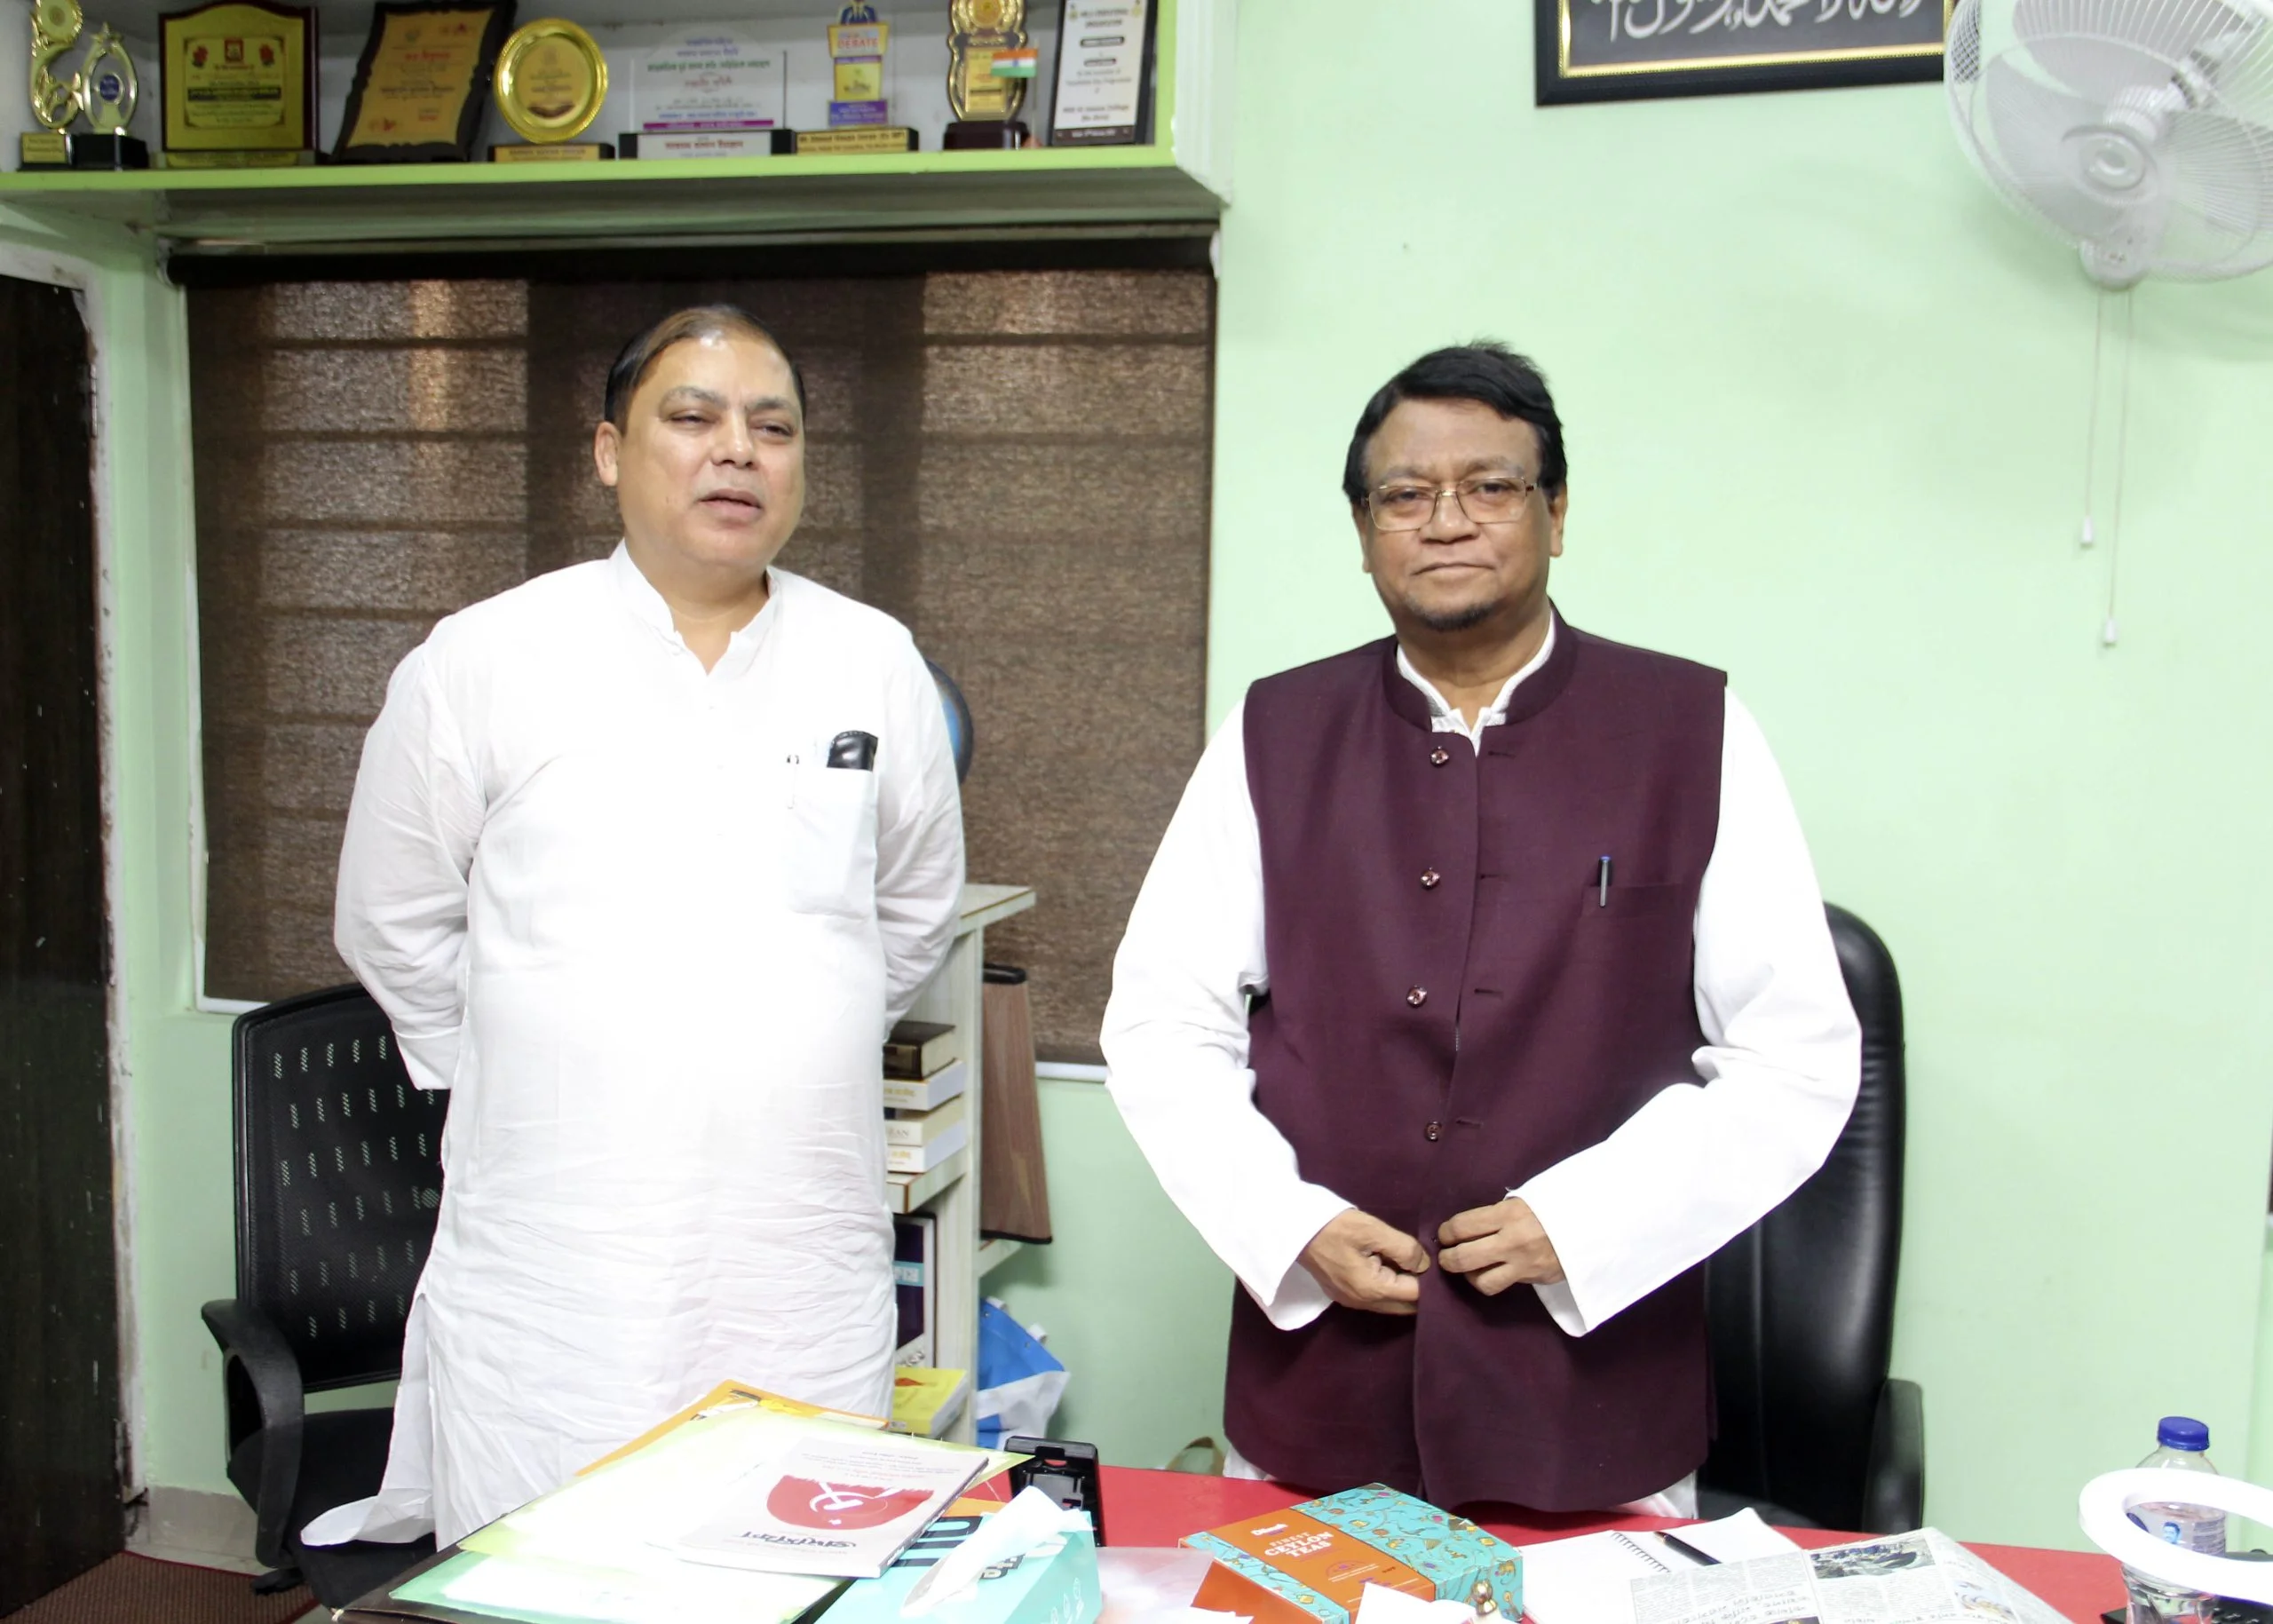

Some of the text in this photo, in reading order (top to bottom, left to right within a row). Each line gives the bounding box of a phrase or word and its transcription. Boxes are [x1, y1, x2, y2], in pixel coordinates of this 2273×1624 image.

[1264, 1532, 1334, 1556] CEYLON
[1269, 1532, 1311, 1547] FINEST
[1285, 1541, 1332, 1557] TEAS
